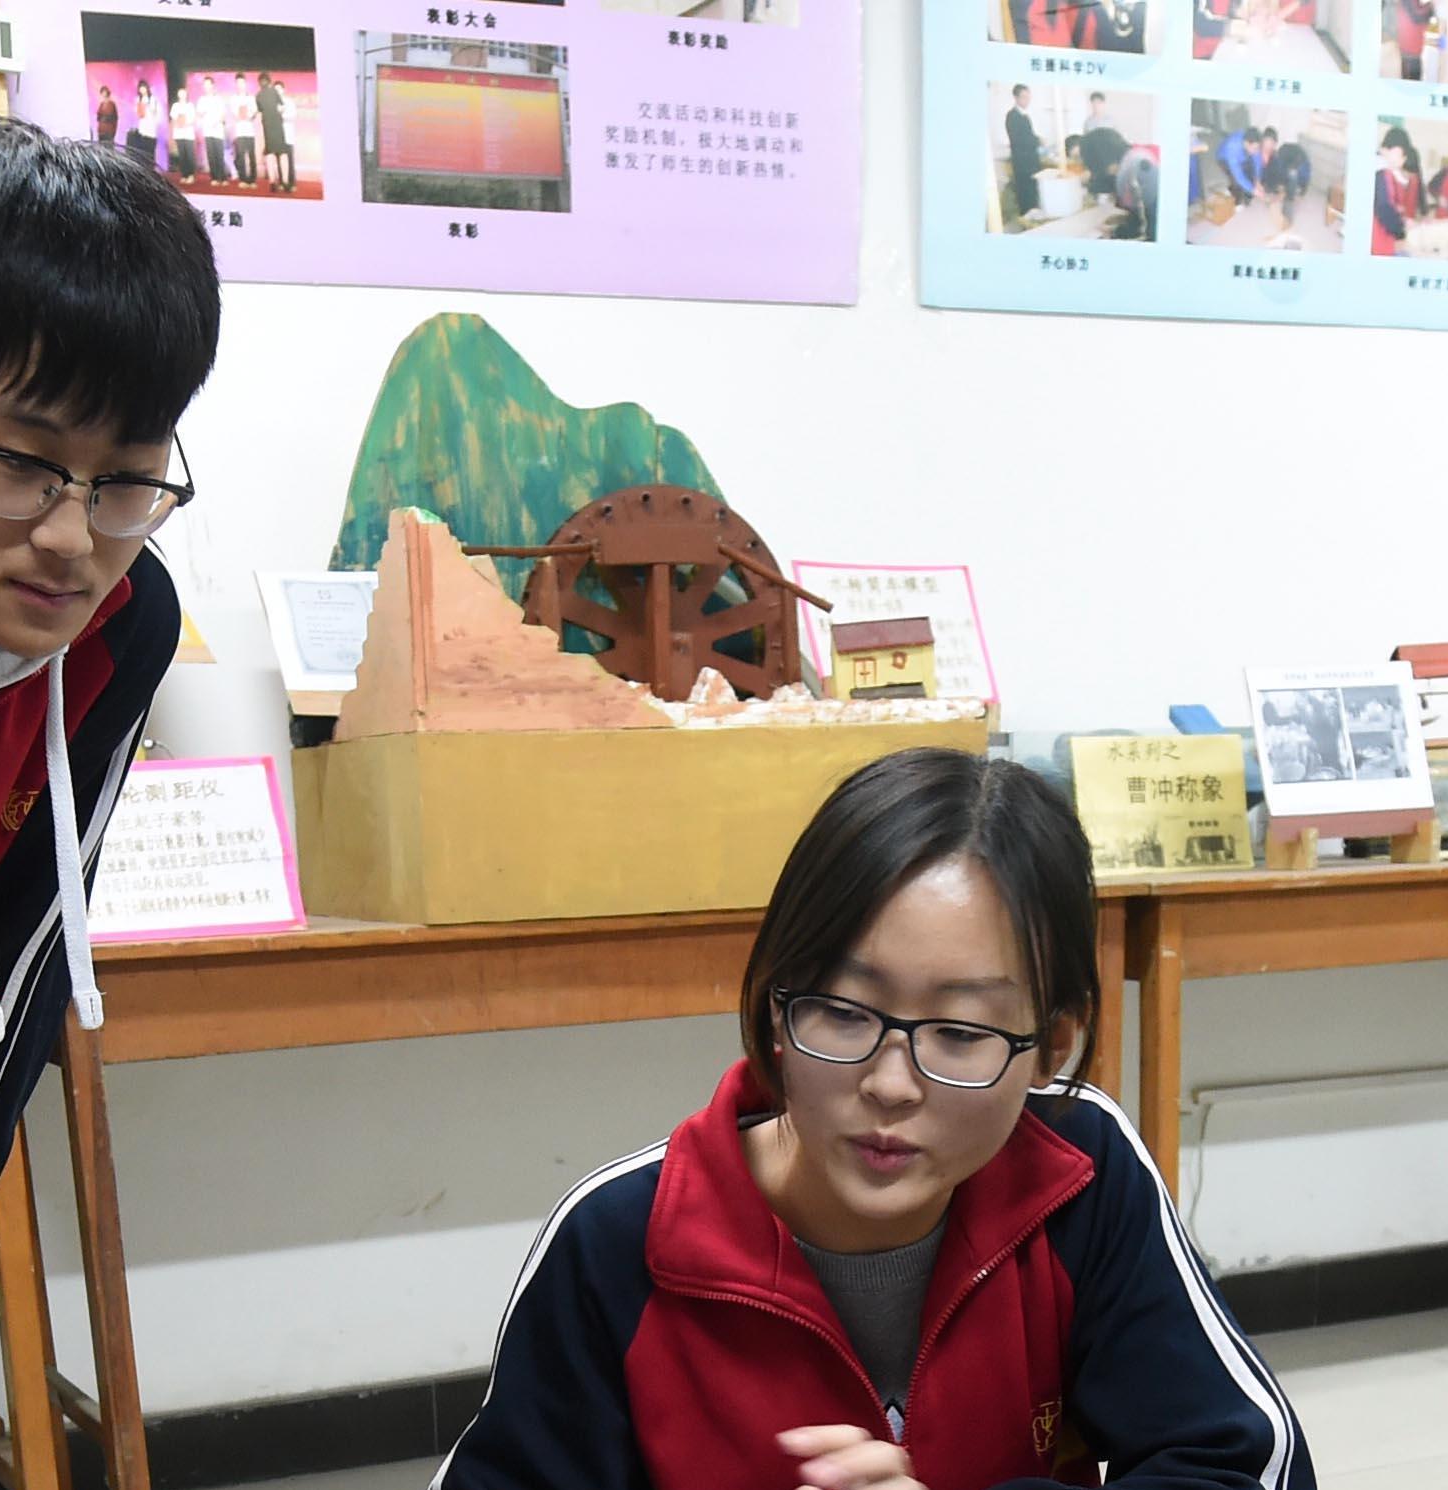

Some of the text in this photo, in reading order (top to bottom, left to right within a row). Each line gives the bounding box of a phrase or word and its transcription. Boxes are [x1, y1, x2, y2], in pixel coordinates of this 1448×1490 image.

[426, 8, 498, 29] 表彰大会
[638, 102, 799, 129] 交流活动和科技创新
[449, 222, 479, 239] 表彰
[1107, 740, 1182, 762] 水系列之
[1126, 774, 1225, 804] 曹冲称象
